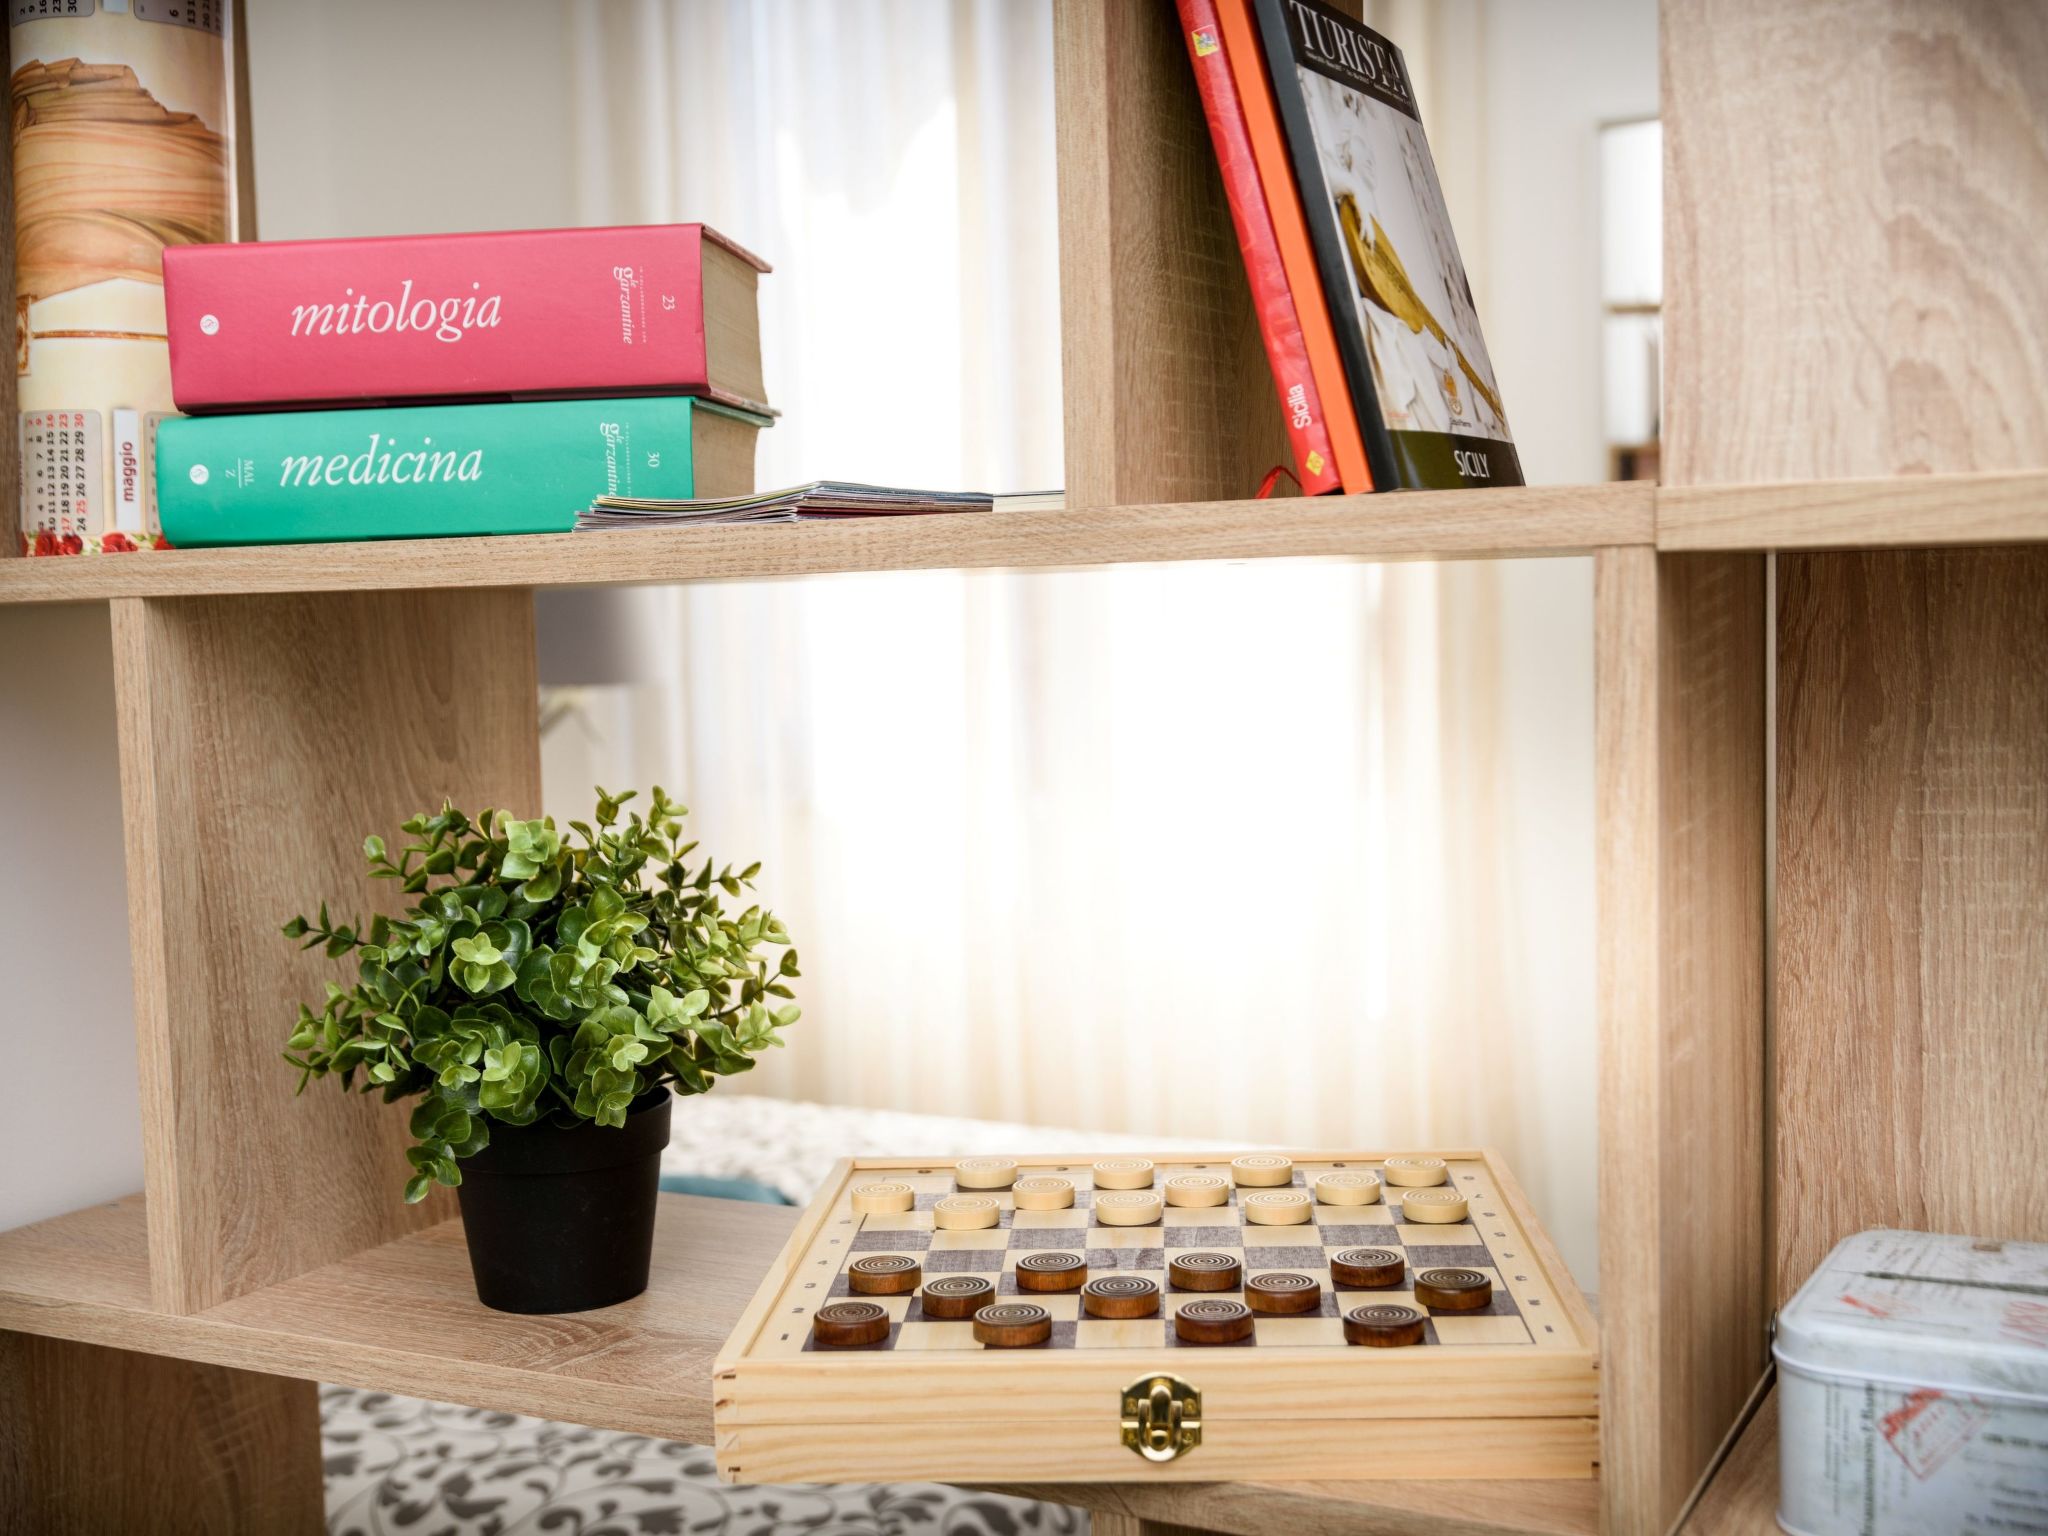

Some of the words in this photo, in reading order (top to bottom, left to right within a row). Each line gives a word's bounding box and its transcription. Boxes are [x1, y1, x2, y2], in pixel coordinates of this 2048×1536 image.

[1288, 0, 1409, 99] TURISTA
[613, 265, 635, 344] garzantine
[661, 294, 676, 311] 23
[290, 278, 502, 343] mitologia
[1286, 383, 1313, 430] Sicilia
[59, 413, 68, 428] 23
[74, 413, 84, 428] 30
[46, 431, 54, 445] 15
[59, 430, 68, 445] 22
[74, 430, 84, 445] 29
[47, 448, 54, 462] 14
[60, 448, 68, 462] 21
[75, 448, 84, 462] 28
[279, 432, 484, 488] medicina
[647, 451, 660, 468] 30
[1453, 449, 1491, 478] SICILY
[47, 466, 55, 480] 13
[60, 465, 69, 480] 20
[75, 465, 84, 480] 27
[119, 441, 137, 502] maggio
[47, 483, 55, 497] 12
[61, 483, 69, 497] 19
[76, 483, 85, 497] 26
[47, 500, 55, 514] 11
[61, 500, 69, 514] 18
[76, 499, 86, 514] 25
[61, 517, 70, 531] 17
[77, 517, 86, 531] 24
